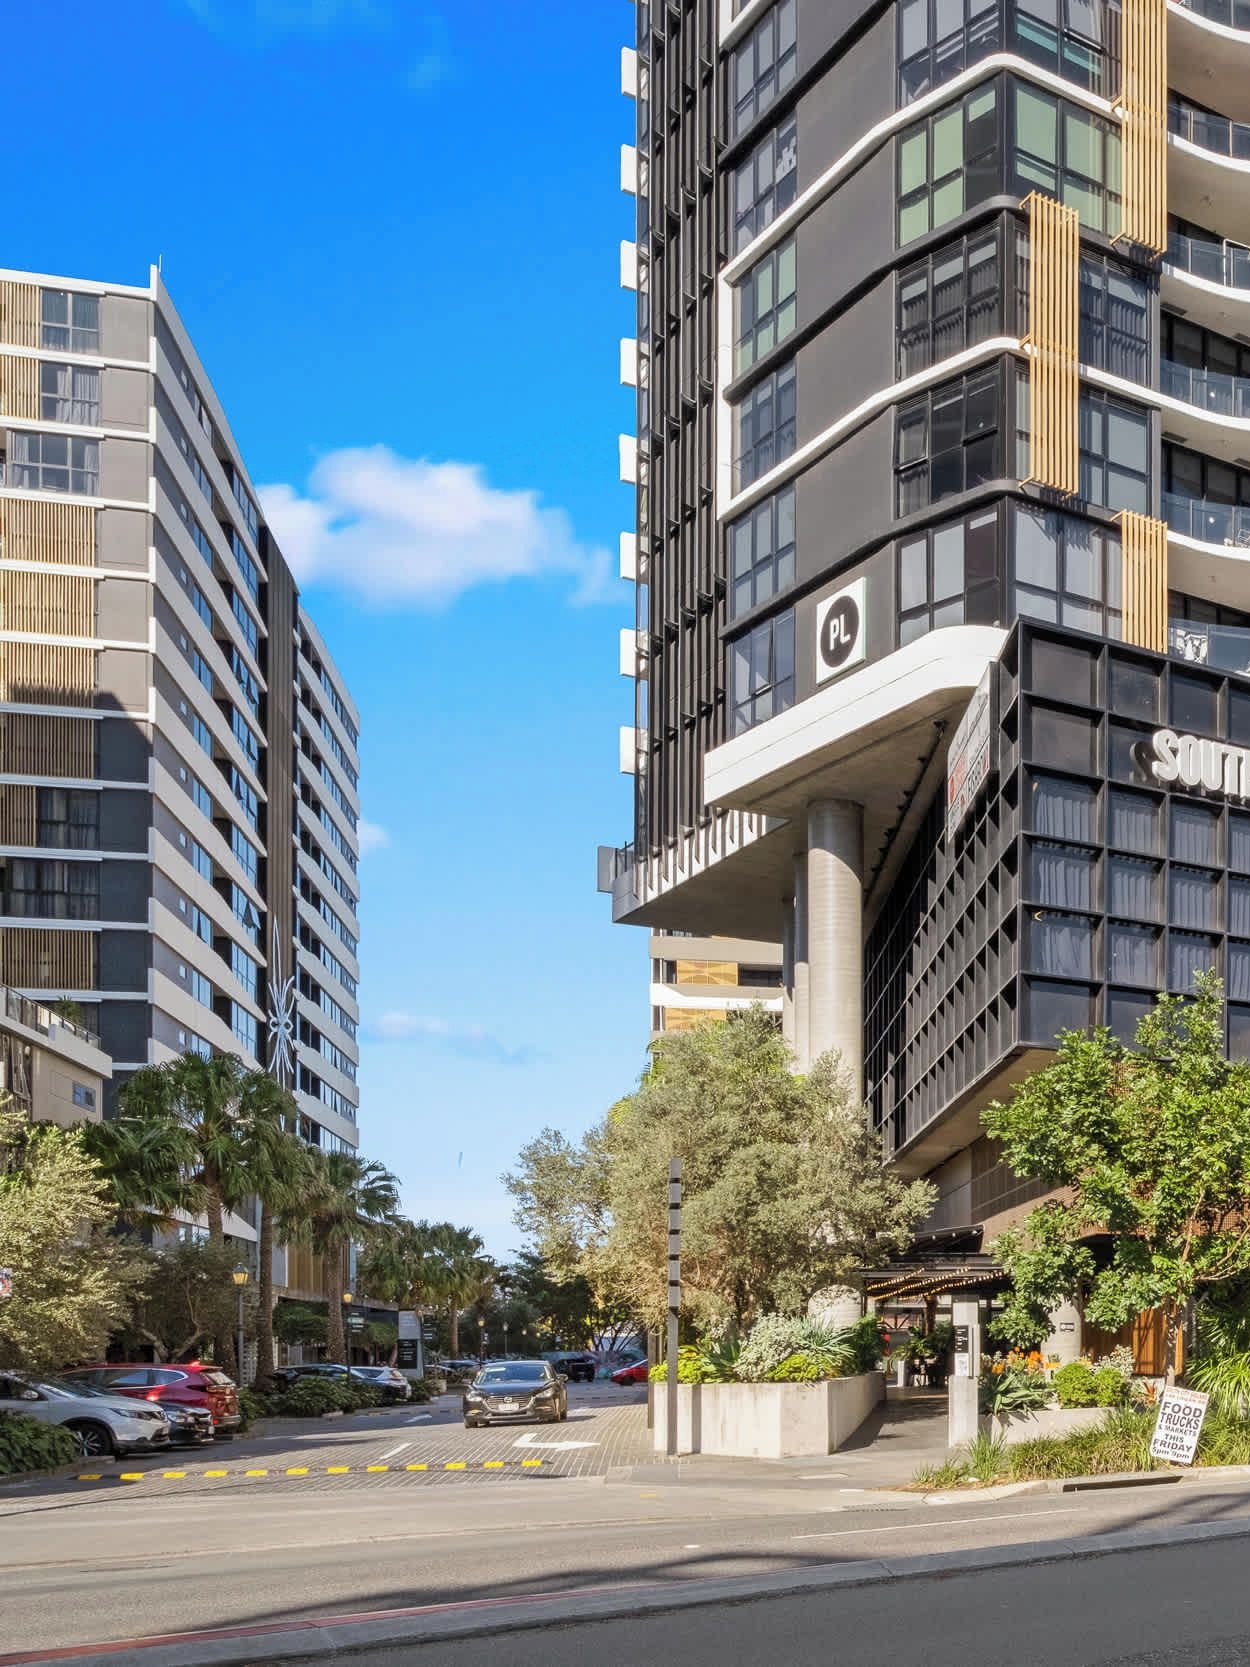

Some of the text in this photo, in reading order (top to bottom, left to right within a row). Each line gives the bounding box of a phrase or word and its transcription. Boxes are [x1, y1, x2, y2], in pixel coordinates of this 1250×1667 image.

[829, 614, 851, 651] PL
[1162, 1401, 1203, 1419] FOOD
[1159, 1411, 1200, 1430] TRUCKS
[1164, 1433, 1185, 1444] THIS
[1165, 1425, 1197, 1437] MARKETS
[1152, 1439, 1193, 1453] FRIDAY
